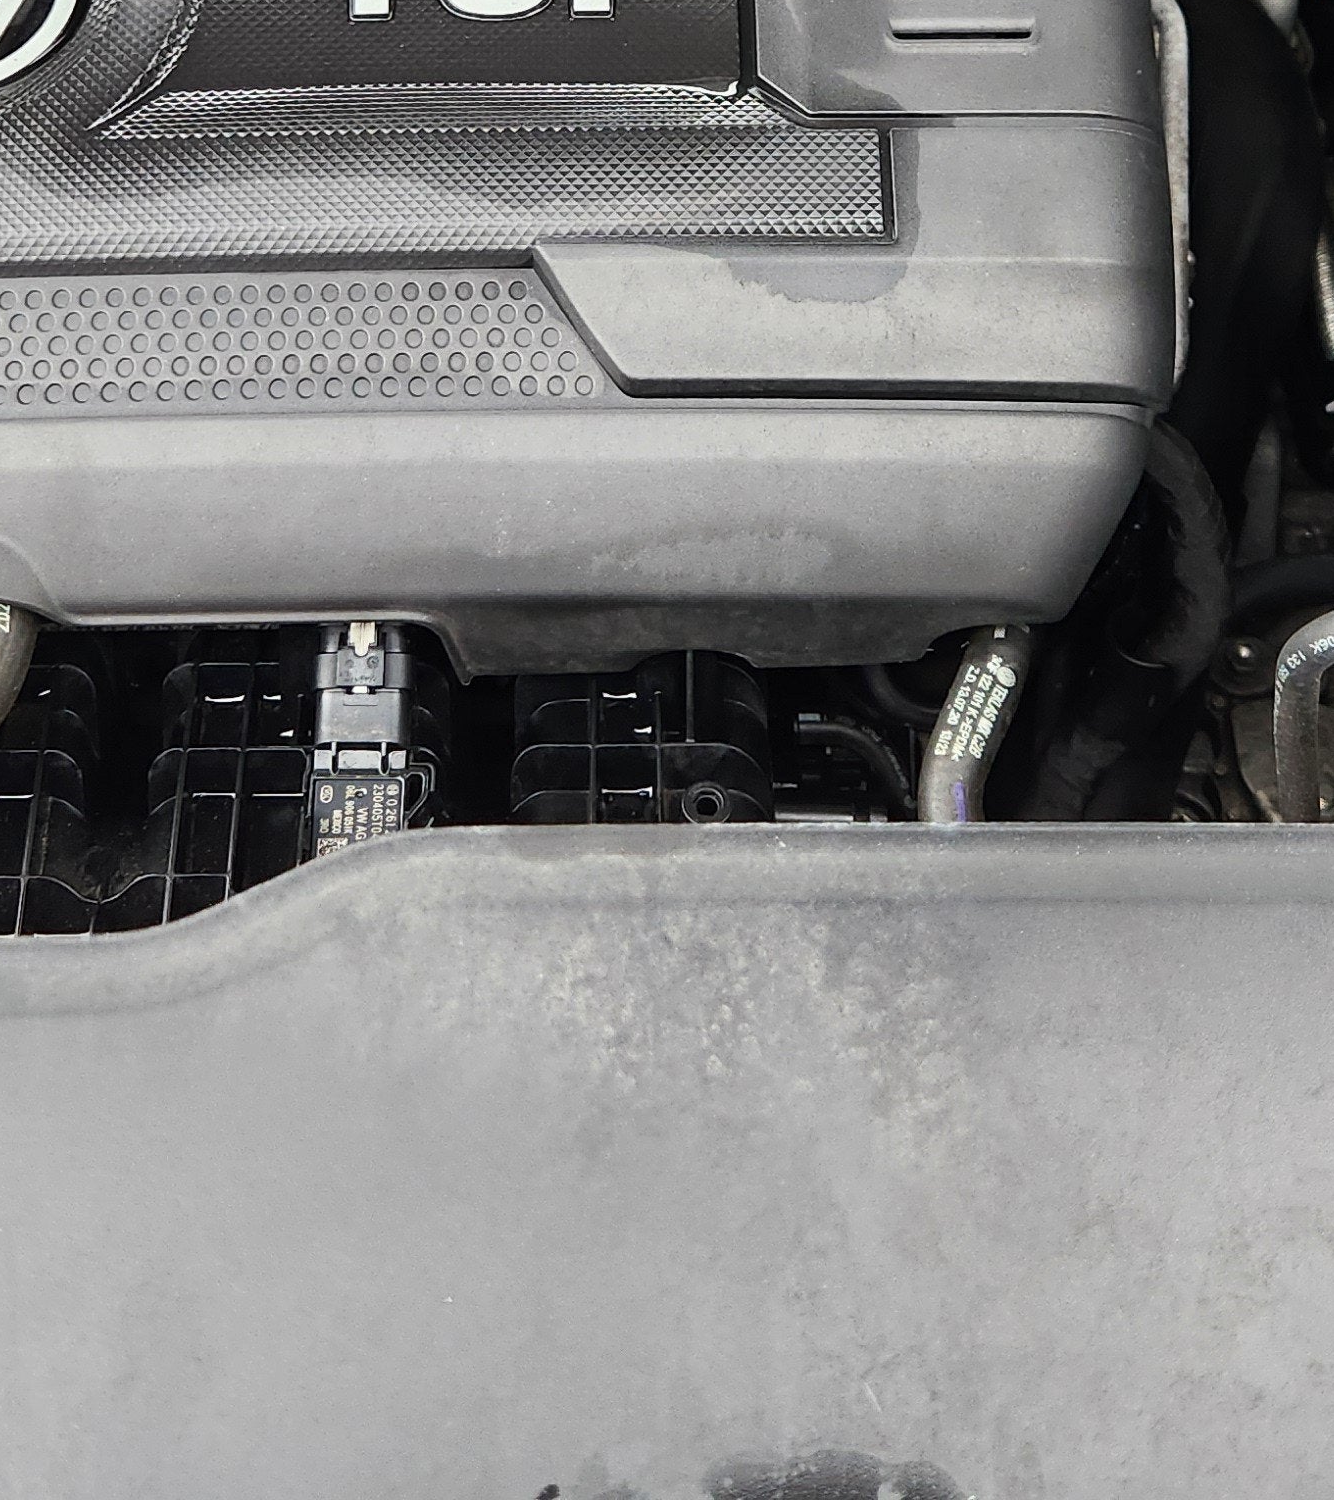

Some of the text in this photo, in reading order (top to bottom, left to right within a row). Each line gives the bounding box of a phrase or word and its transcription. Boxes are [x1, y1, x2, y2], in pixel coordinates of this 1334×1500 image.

[983, 683, 1009, 723] TEKLAS
[355, 806, 369, 841] VW AG
[370, 783, 385, 837] 230405T0
